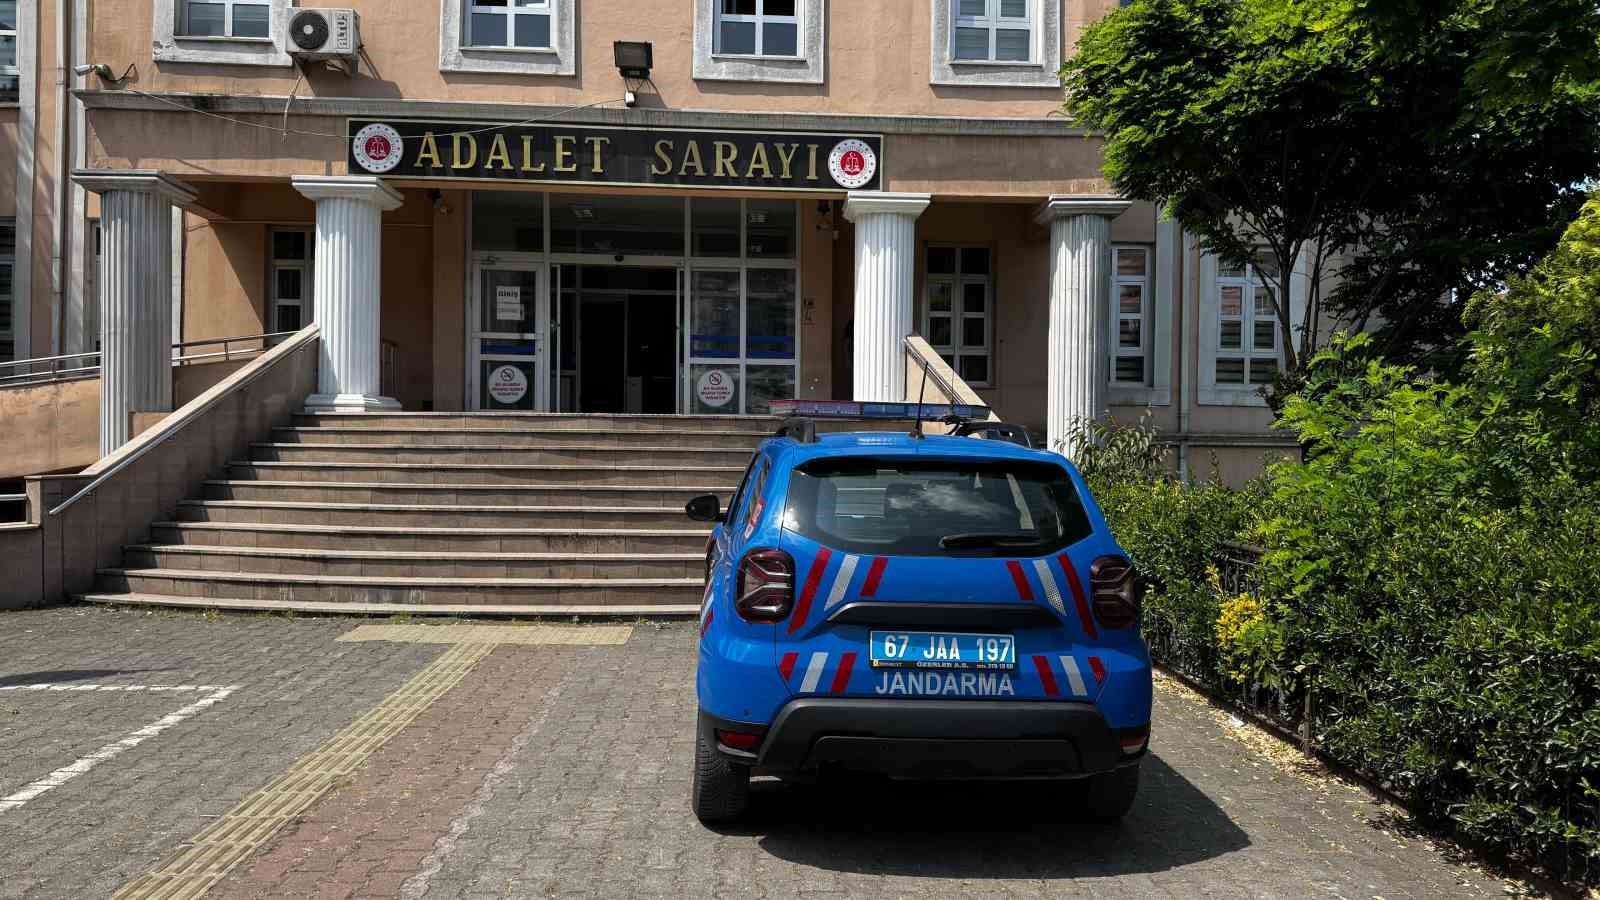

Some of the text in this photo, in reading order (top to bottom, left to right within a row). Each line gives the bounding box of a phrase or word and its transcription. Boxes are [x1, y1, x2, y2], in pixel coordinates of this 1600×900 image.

[413, 131, 611, 173] ADALET
[651, 139, 820, 181] SARAYI
[884, 634, 1011, 662] 67 JAA 197
[875, 671, 1015, 696] JANDARMA
